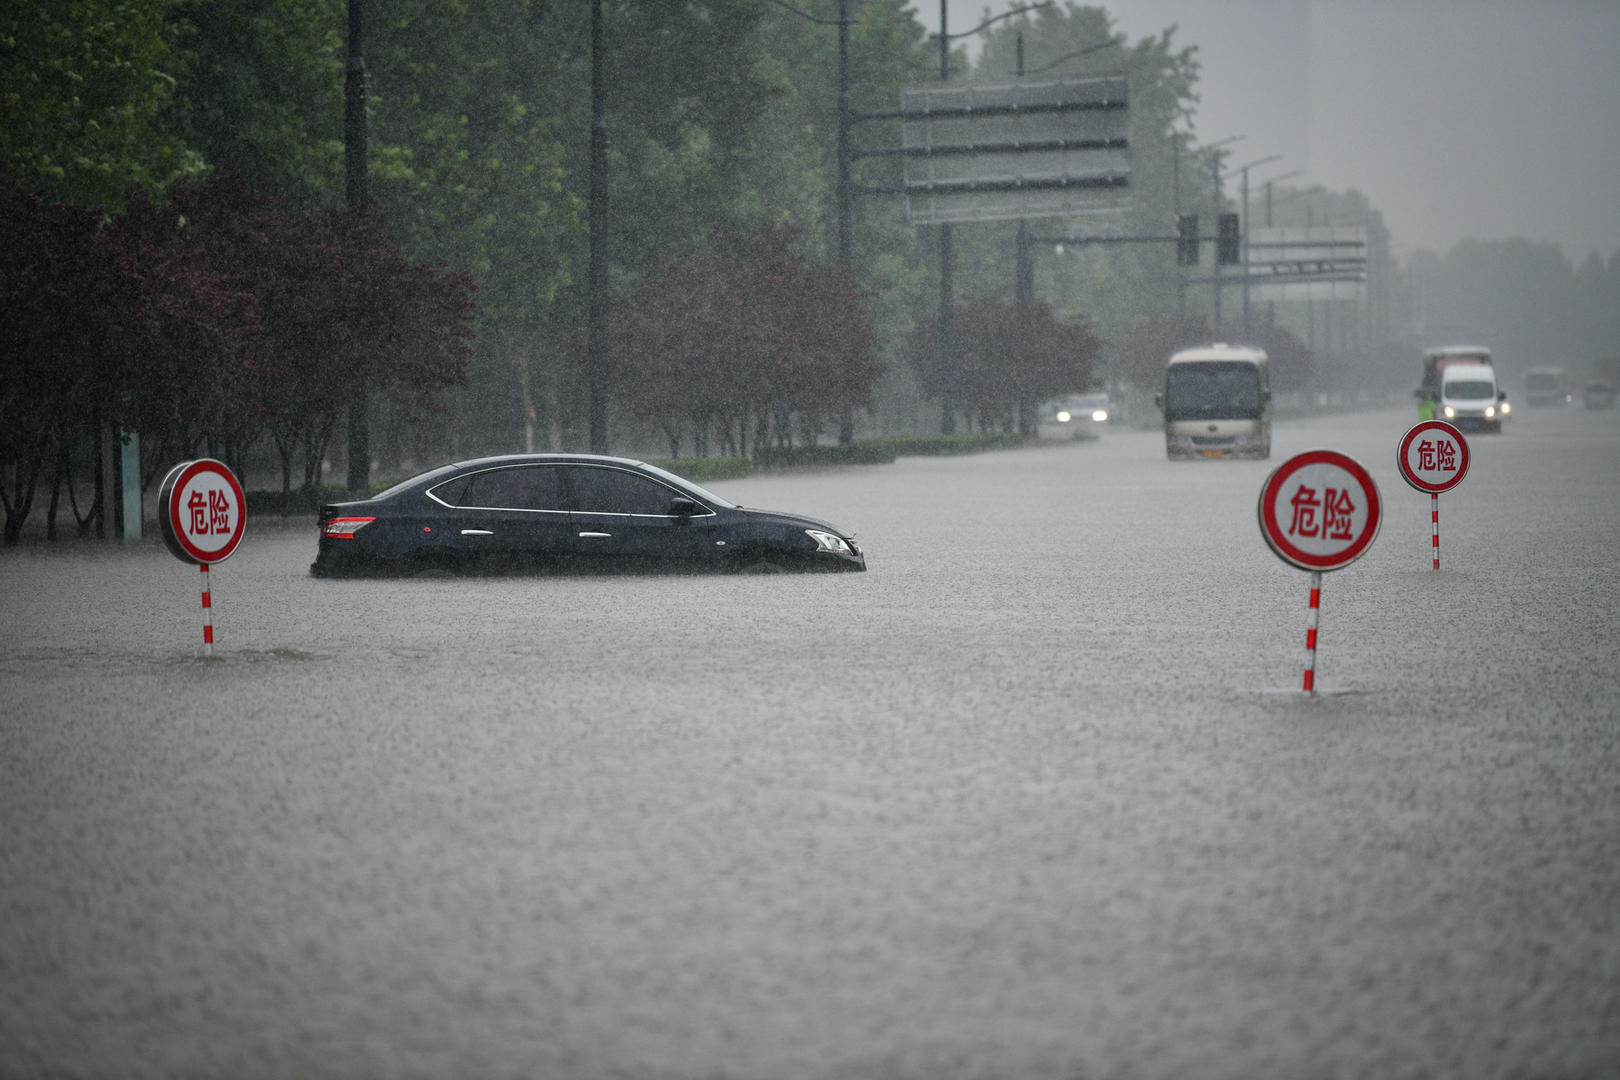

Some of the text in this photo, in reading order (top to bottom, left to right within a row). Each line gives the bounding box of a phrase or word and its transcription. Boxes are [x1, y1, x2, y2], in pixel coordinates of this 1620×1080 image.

[1417, 440, 1456, 471] 危险
[187, 489, 230, 536] 危险
[1289, 484, 1356, 540] 危险
